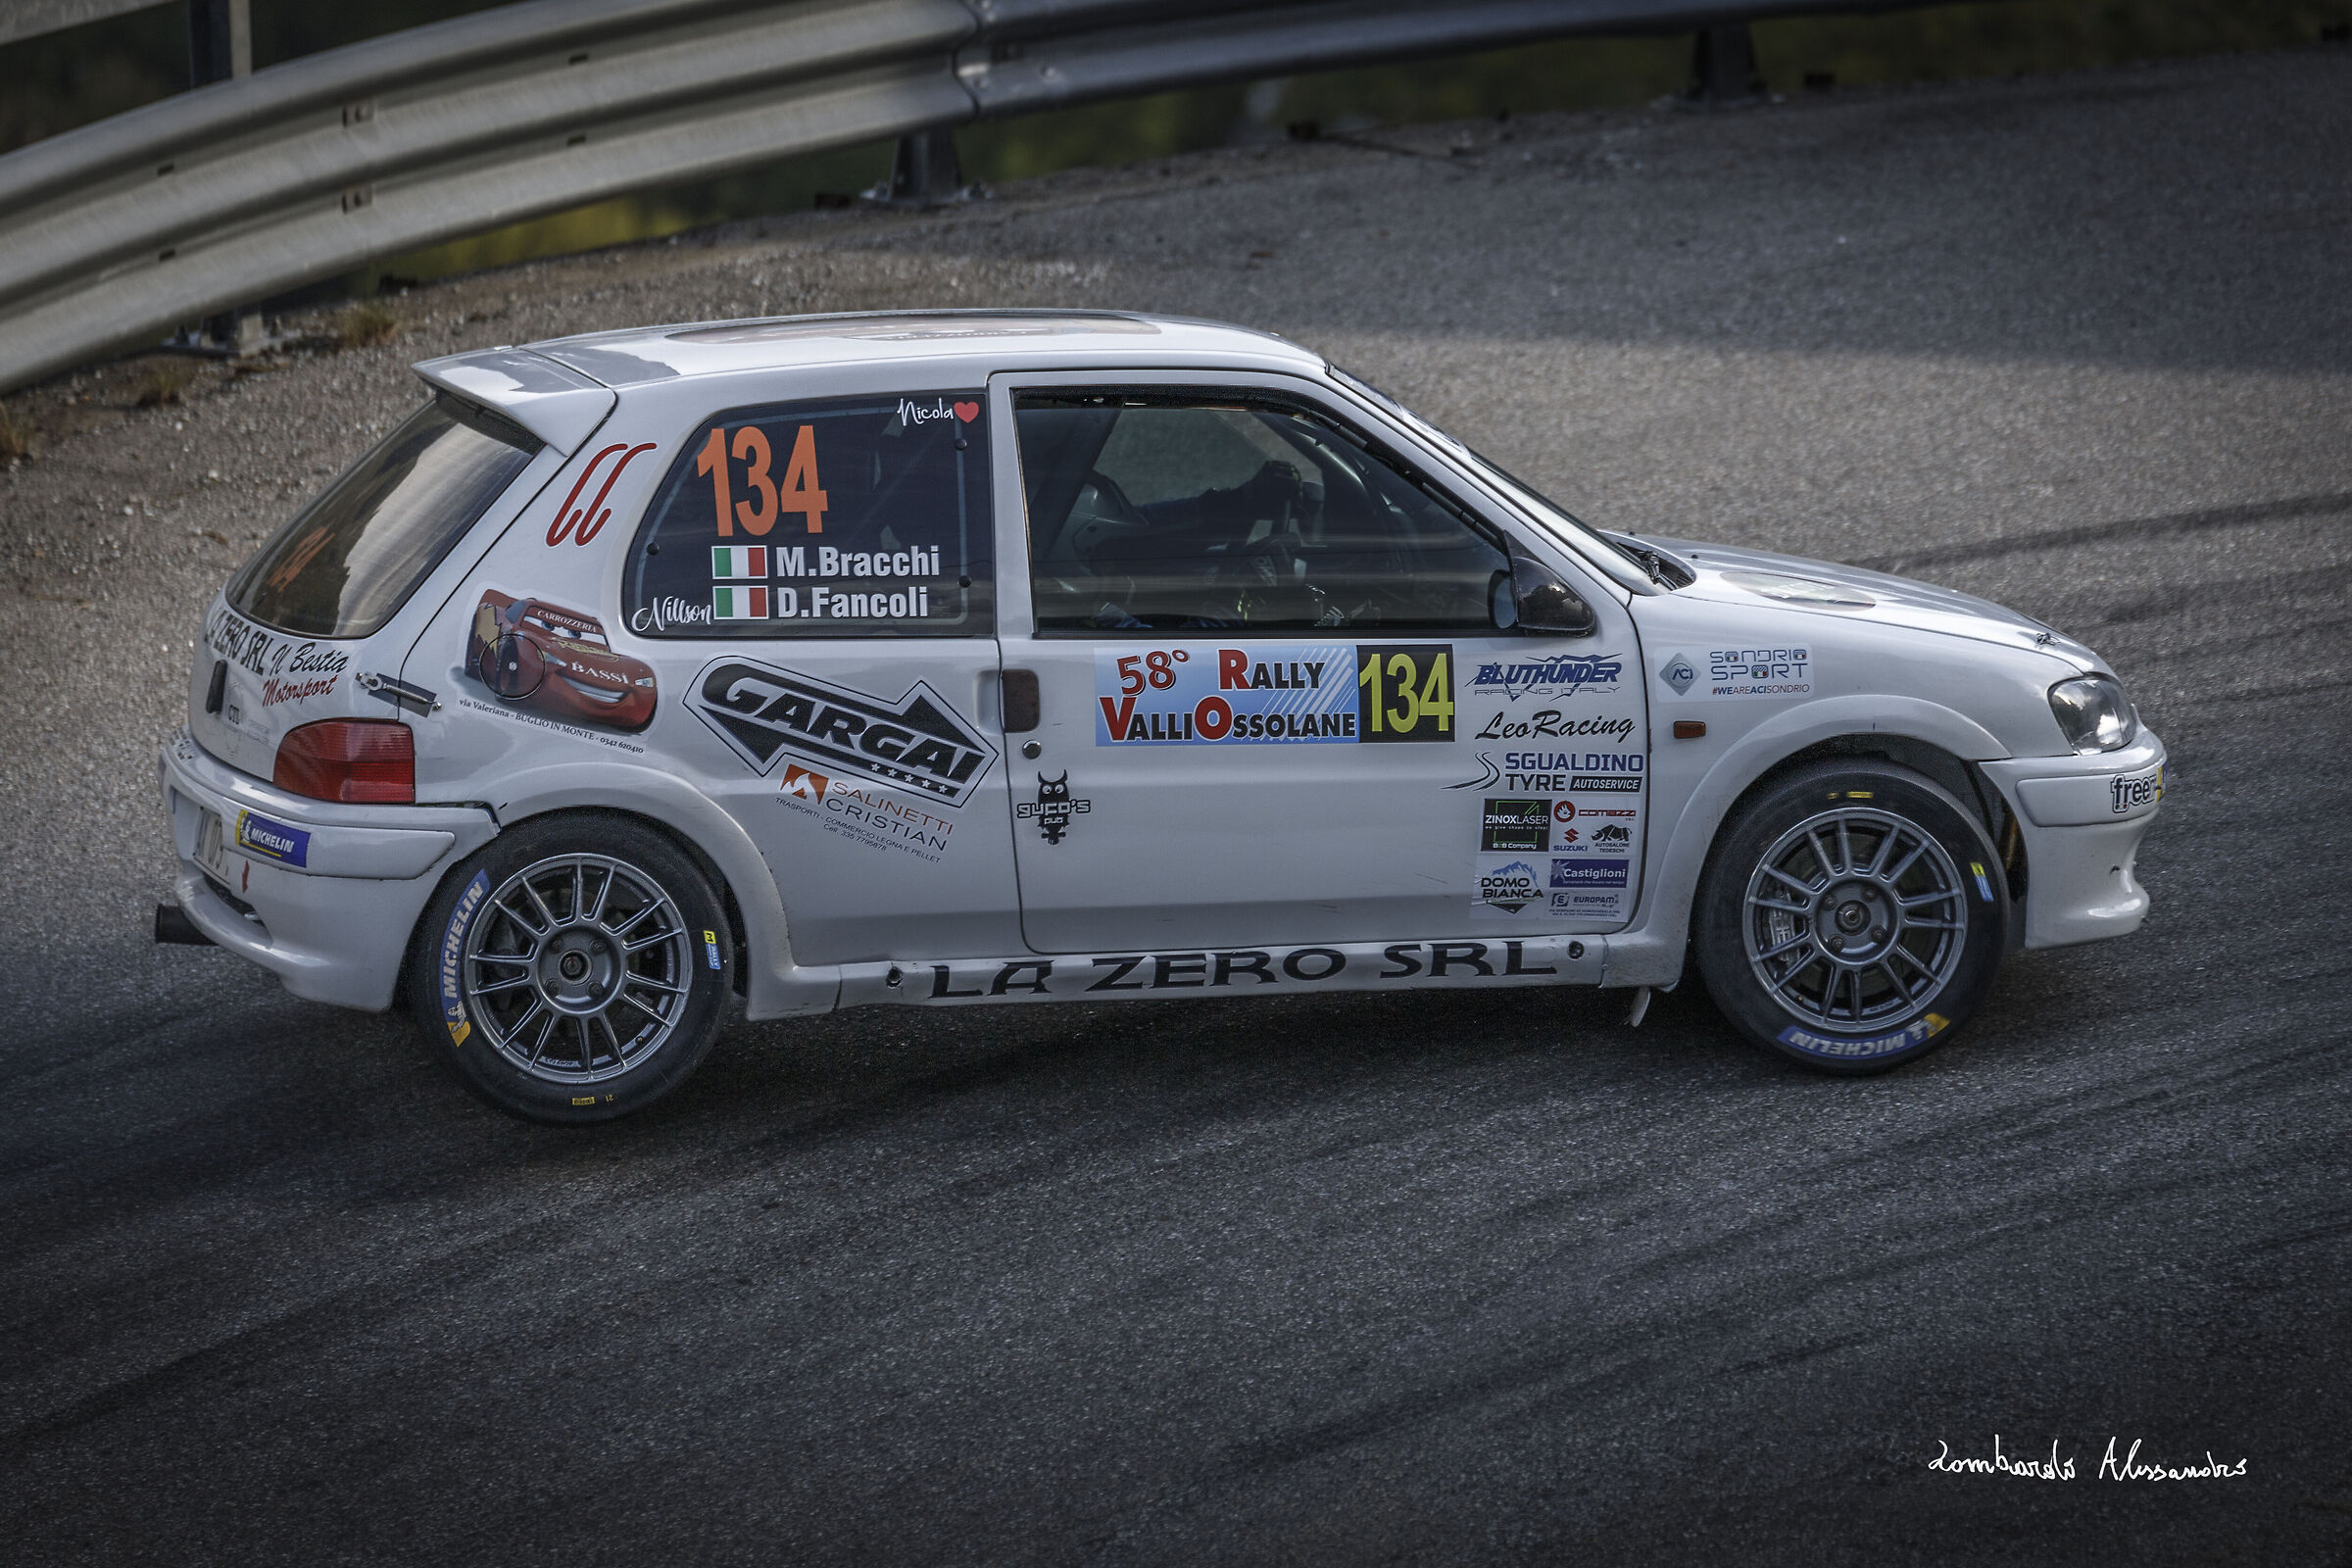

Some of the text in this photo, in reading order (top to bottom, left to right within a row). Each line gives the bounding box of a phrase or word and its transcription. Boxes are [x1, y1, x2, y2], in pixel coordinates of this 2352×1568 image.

[897, 398, 954, 427] Nicola
[697, 424, 828, 537] 134
[775, 545, 940, 578] M.Bracchi
[631, 596, 712, 633] Nillson
[777, 586, 929, 618] D.Fancoli
[537, 610, 599, 633] CARROZZERIA
[214, 613, 251, 660] ZERO
[240, 630, 274, 676] SRL
[289, 642, 349, 673] Bestia
[1709, 649, 1807, 663] SONDRIO
[571, 662, 630, 684] BASSI
[1116, 648, 1326, 696] 58° RALLY
[1474, 661, 1623, 686] BLUTHUNDER
[1672, 668, 1693, 680] ACI
[1710, 663, 1808, 681] SPORT
[263, 674, 338, 708] Motorsport
[1359, 652, 1454, 734] 134
[1474, 686, 1622, 696] RACING ITALY
[1712, 684, 1810, 696] #WEAREACISONDRIO
[459, 698, 471, 708] via
[473, 701, 509, 718] Valeriana
[515, 712, 549, 729] BUGLIO
[551, 721, 561, 733] IN
[562, 725, 595, 741] MONTE
[600, 737, 617, 747] 0342
[1505, 752, 1644, 772] SGUALDINO
[1505, 773, 1640, 792] TYRE AUTOSERVICE
[832, 781, 954, 835] SALINETTI
[1485, 814, 1549, 824] ZINOXLASER
[775, 797, 820, 819] TRASPORTI
[825, 816, 875, 840] COMMERCIO
[876, 835, 903, 851] LEGNA
[911, 850, 941, 863] PELLET
[826, 798, 948, 852] CRISTIAN
[249, 827, 295, 854] MICHELIN
[1481, 877, 1530, 888] DOMO
[1563, 868, 1627, 879] Castiglioni
[1482, 888, 1544, 898] BIANCA
[444, 880, 485, 1000] MICHELIN
[927, 940, 1558, 999] LA ZERO SRL
[1788, 1033, 1908, 1056] MICHELIN
